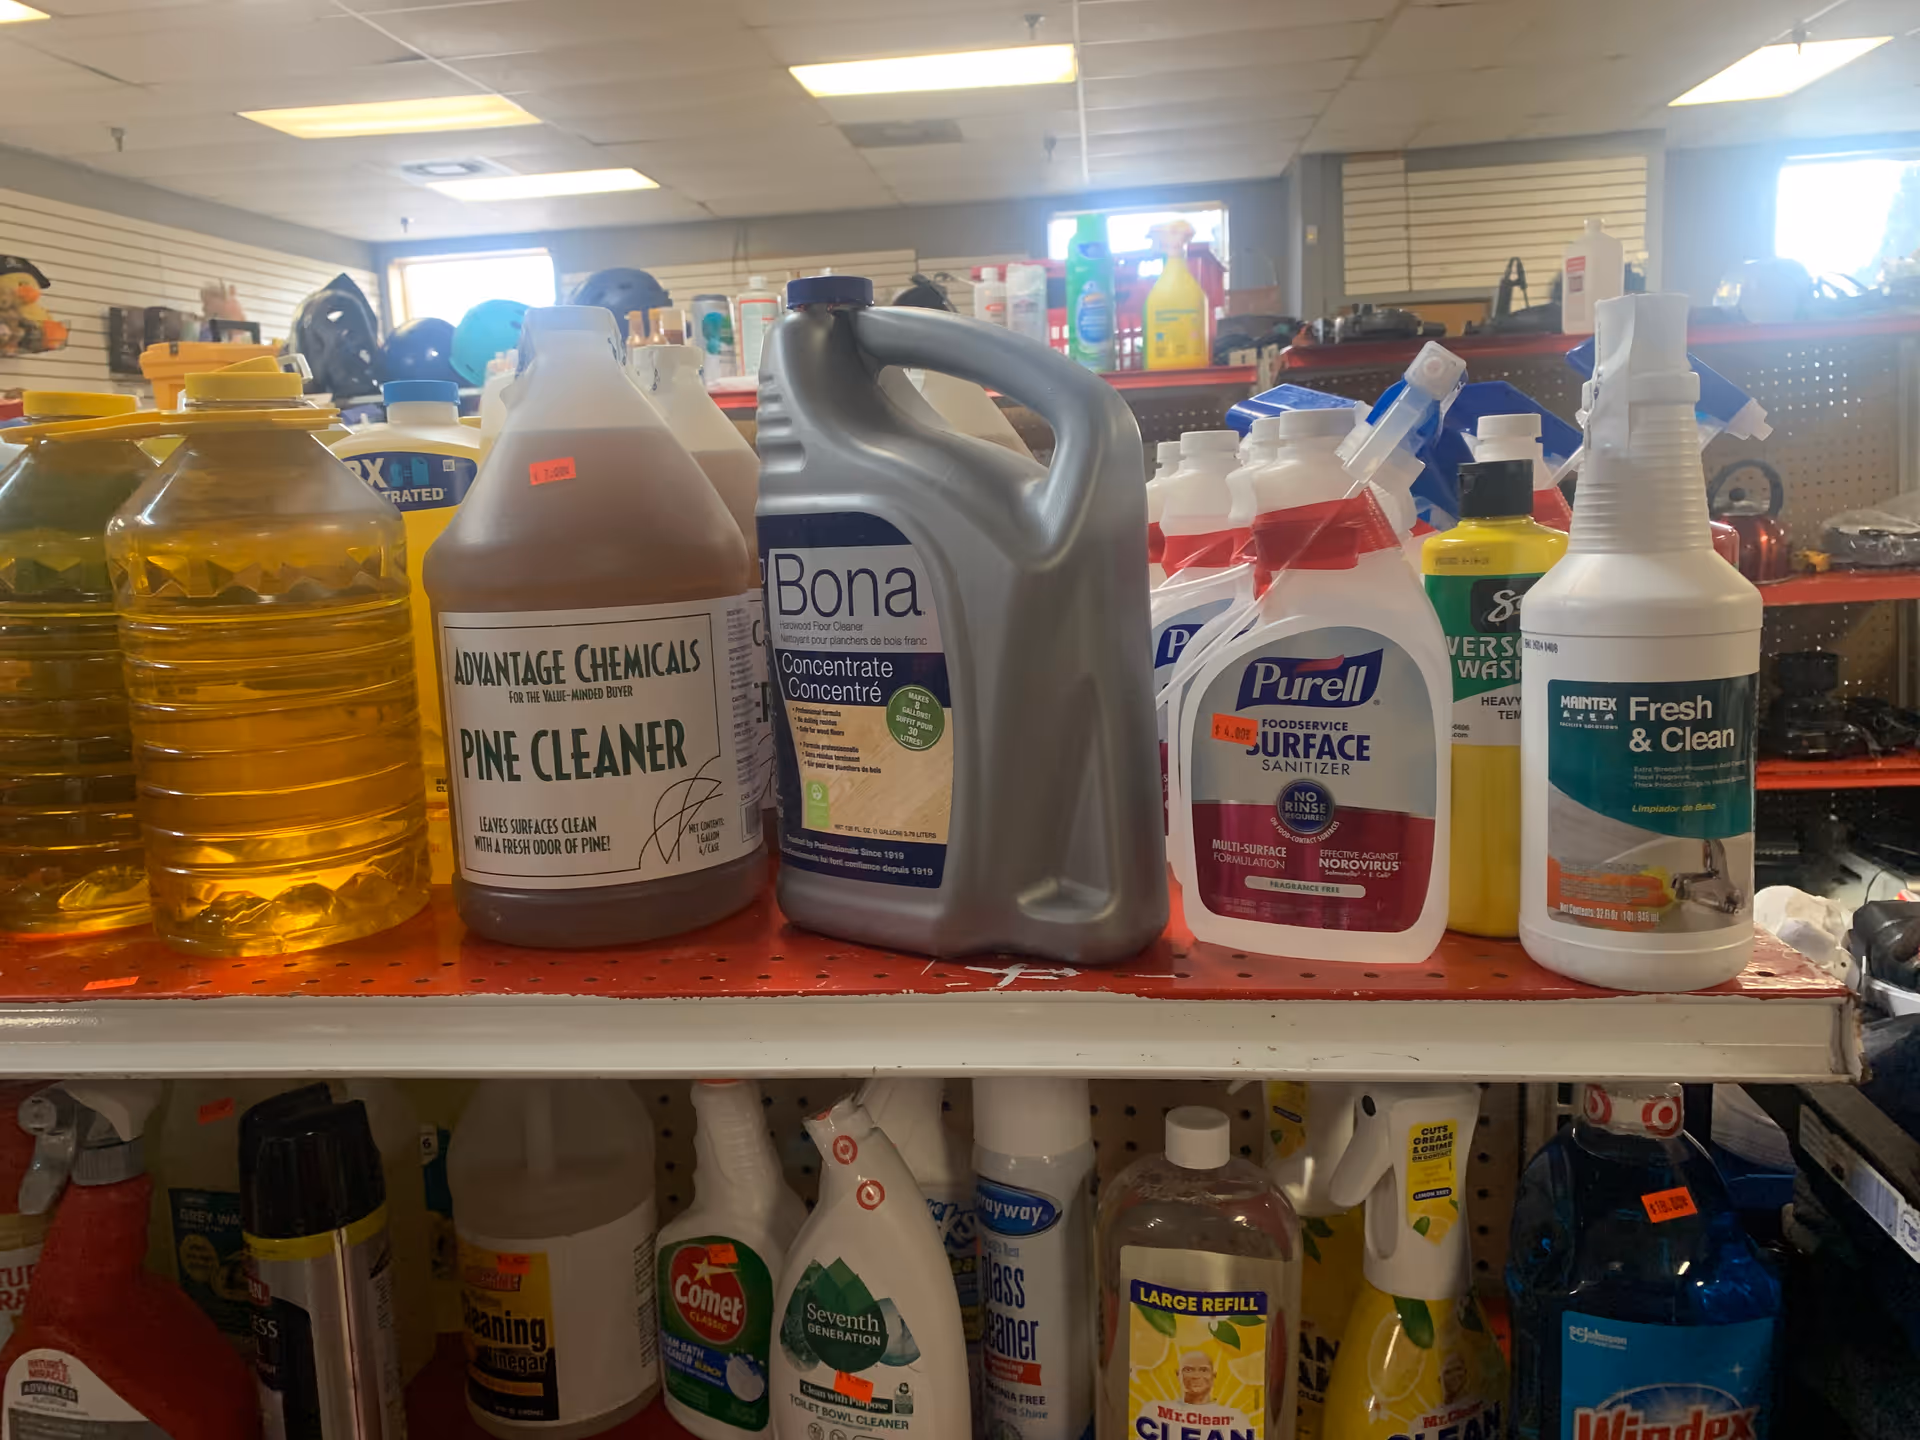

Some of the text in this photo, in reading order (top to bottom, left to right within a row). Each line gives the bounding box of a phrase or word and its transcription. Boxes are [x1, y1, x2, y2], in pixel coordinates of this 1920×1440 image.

[381, 488, 444, 503] TRATED
[774, 553, 922, 618] Bona
[813, 621, 831, 631] Floor
[833, 621, 863, 631] Cleaner
[812, 636, 828, 645] pour
[830, 635, 868, 646] planchers
[871, 636, 881, 645] de
[884, 636, 901, 645] bois
[904, 636, 927, 646] franc
[454, 638, 700, 687] ADVANTAGE CHEMICALS
[782, 652, 893, 678] Concentrate
[788, 677, 881, 703] Concentré
[1252, 663, 1368, 703] Purell
[526, 690, 540, 702] THE
[542, 687, 604, 702] VALUE-MINDED
[606, 685, 633, 699] BUYER
[908, 692, 930, 704] MAKES
[1560, 695, 1618, 711] MAINTEX
[1629, 695, 1713, 721] Fresh
[902, 706, 931, 720] GALLONS!
[895, 715, 933, 732] SUFFIT POUR
[908, 726, 918, 736] 30
[1262, 719, 1348, 732] FOODSERVICE
[1246, 732, 1371, 761] SURFACE
[1629, 726, 1735, 753] & Clean
[460, 718, 687, 782] PINE CLEANER
[1262, 760, 1350, 776] SANITIZER
[1294, 791, 1317, 803] NO
[1284, 812, 1327, 821] REQUIRED
[1285, 802, 1327, 814] RINSE
[1632, 804, 1680, 813] Limpiador
[479, 815, 597, 835] LEAVES SURFACES CLEAN
[474, 835, 611, 855] WITH A FRESH ODOR OF PINE!
[1212, 839, 1288, 858] MULTI-SURFACE
[860, 848, 882, 858] Since
[884, 851, 904, 860] 1919
[1213, 852, 1286, 869] FORMULATION
[1319, 849, 1399, 861] EFFECTIVE AGAINST
[844, 860, 880, 871] confiance
[882, 863, 909, 874] depuis
[911, 867, 933, 876] 1919
[1270, 880, 1340, 894] FRAGRANCE FREE
[1413, 1131, 1454, 1145] GREASE
[1421, 1124, 1448, 1136] CUTS
[1412, 1141, 1453, 1154] & GRIME
[1415, 1191, 1435, 1200] LEMON
[981, 1252, 1025, 1309] lass
[675, 1274, 743, 1326] Comet
[1140, 1287, 1259, 1313] LARGE REFILL
[463, 1298, 546, 1352] eaning
[689, 1311, 728, 1333] CLASSIC
[807, 1303, 880, 1333] Seventh
[808, 1323, 881, 1346] GENERATION
[986, 1309, 1039, 1360] eaner
[23, 1383, 76, 1401] ADVANCED
[802, 1383, 826, 1398] Clean
[827, 1392, 849, 1404] with
[1019, 1394, 1046, 1406] FREE
[789, 1394, 820, 1414] TOILET
[822, 1407, 854, 1423] BOWL
[856, 1414, 909, 1430] CLEANER
